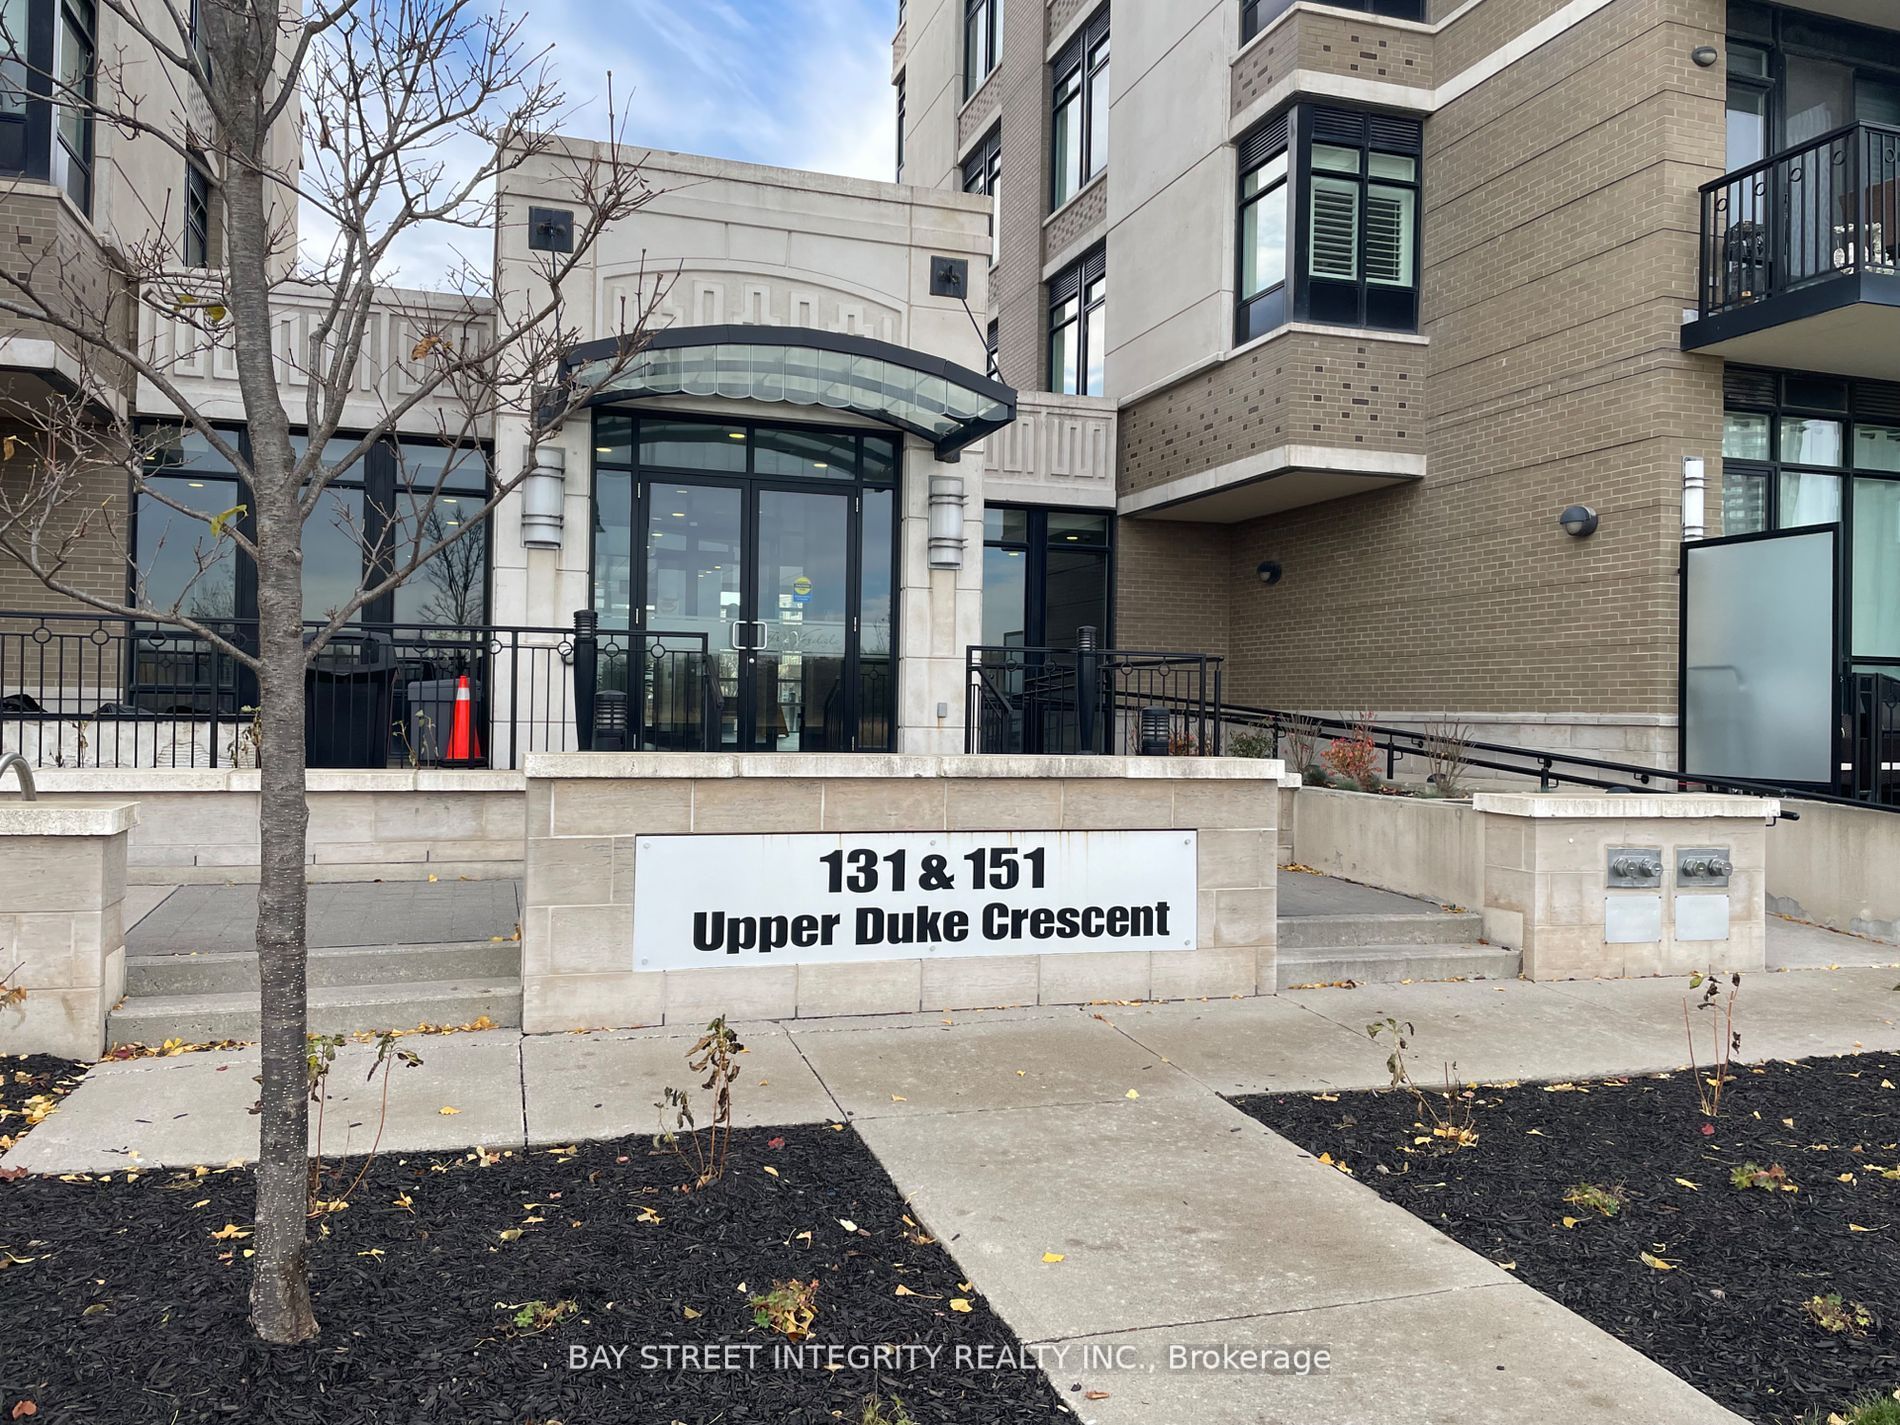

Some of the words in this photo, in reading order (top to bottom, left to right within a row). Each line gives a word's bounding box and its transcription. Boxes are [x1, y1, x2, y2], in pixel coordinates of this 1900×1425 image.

[820, 849, 905, 893] 131
[917, 855, 955, 890] &
[964, 847, 1045, 890] 151
[694, 911, 840, 955] Upper
[855, 905, 969, 945] Duke
[983, 902, 1170, 940] Crescent
